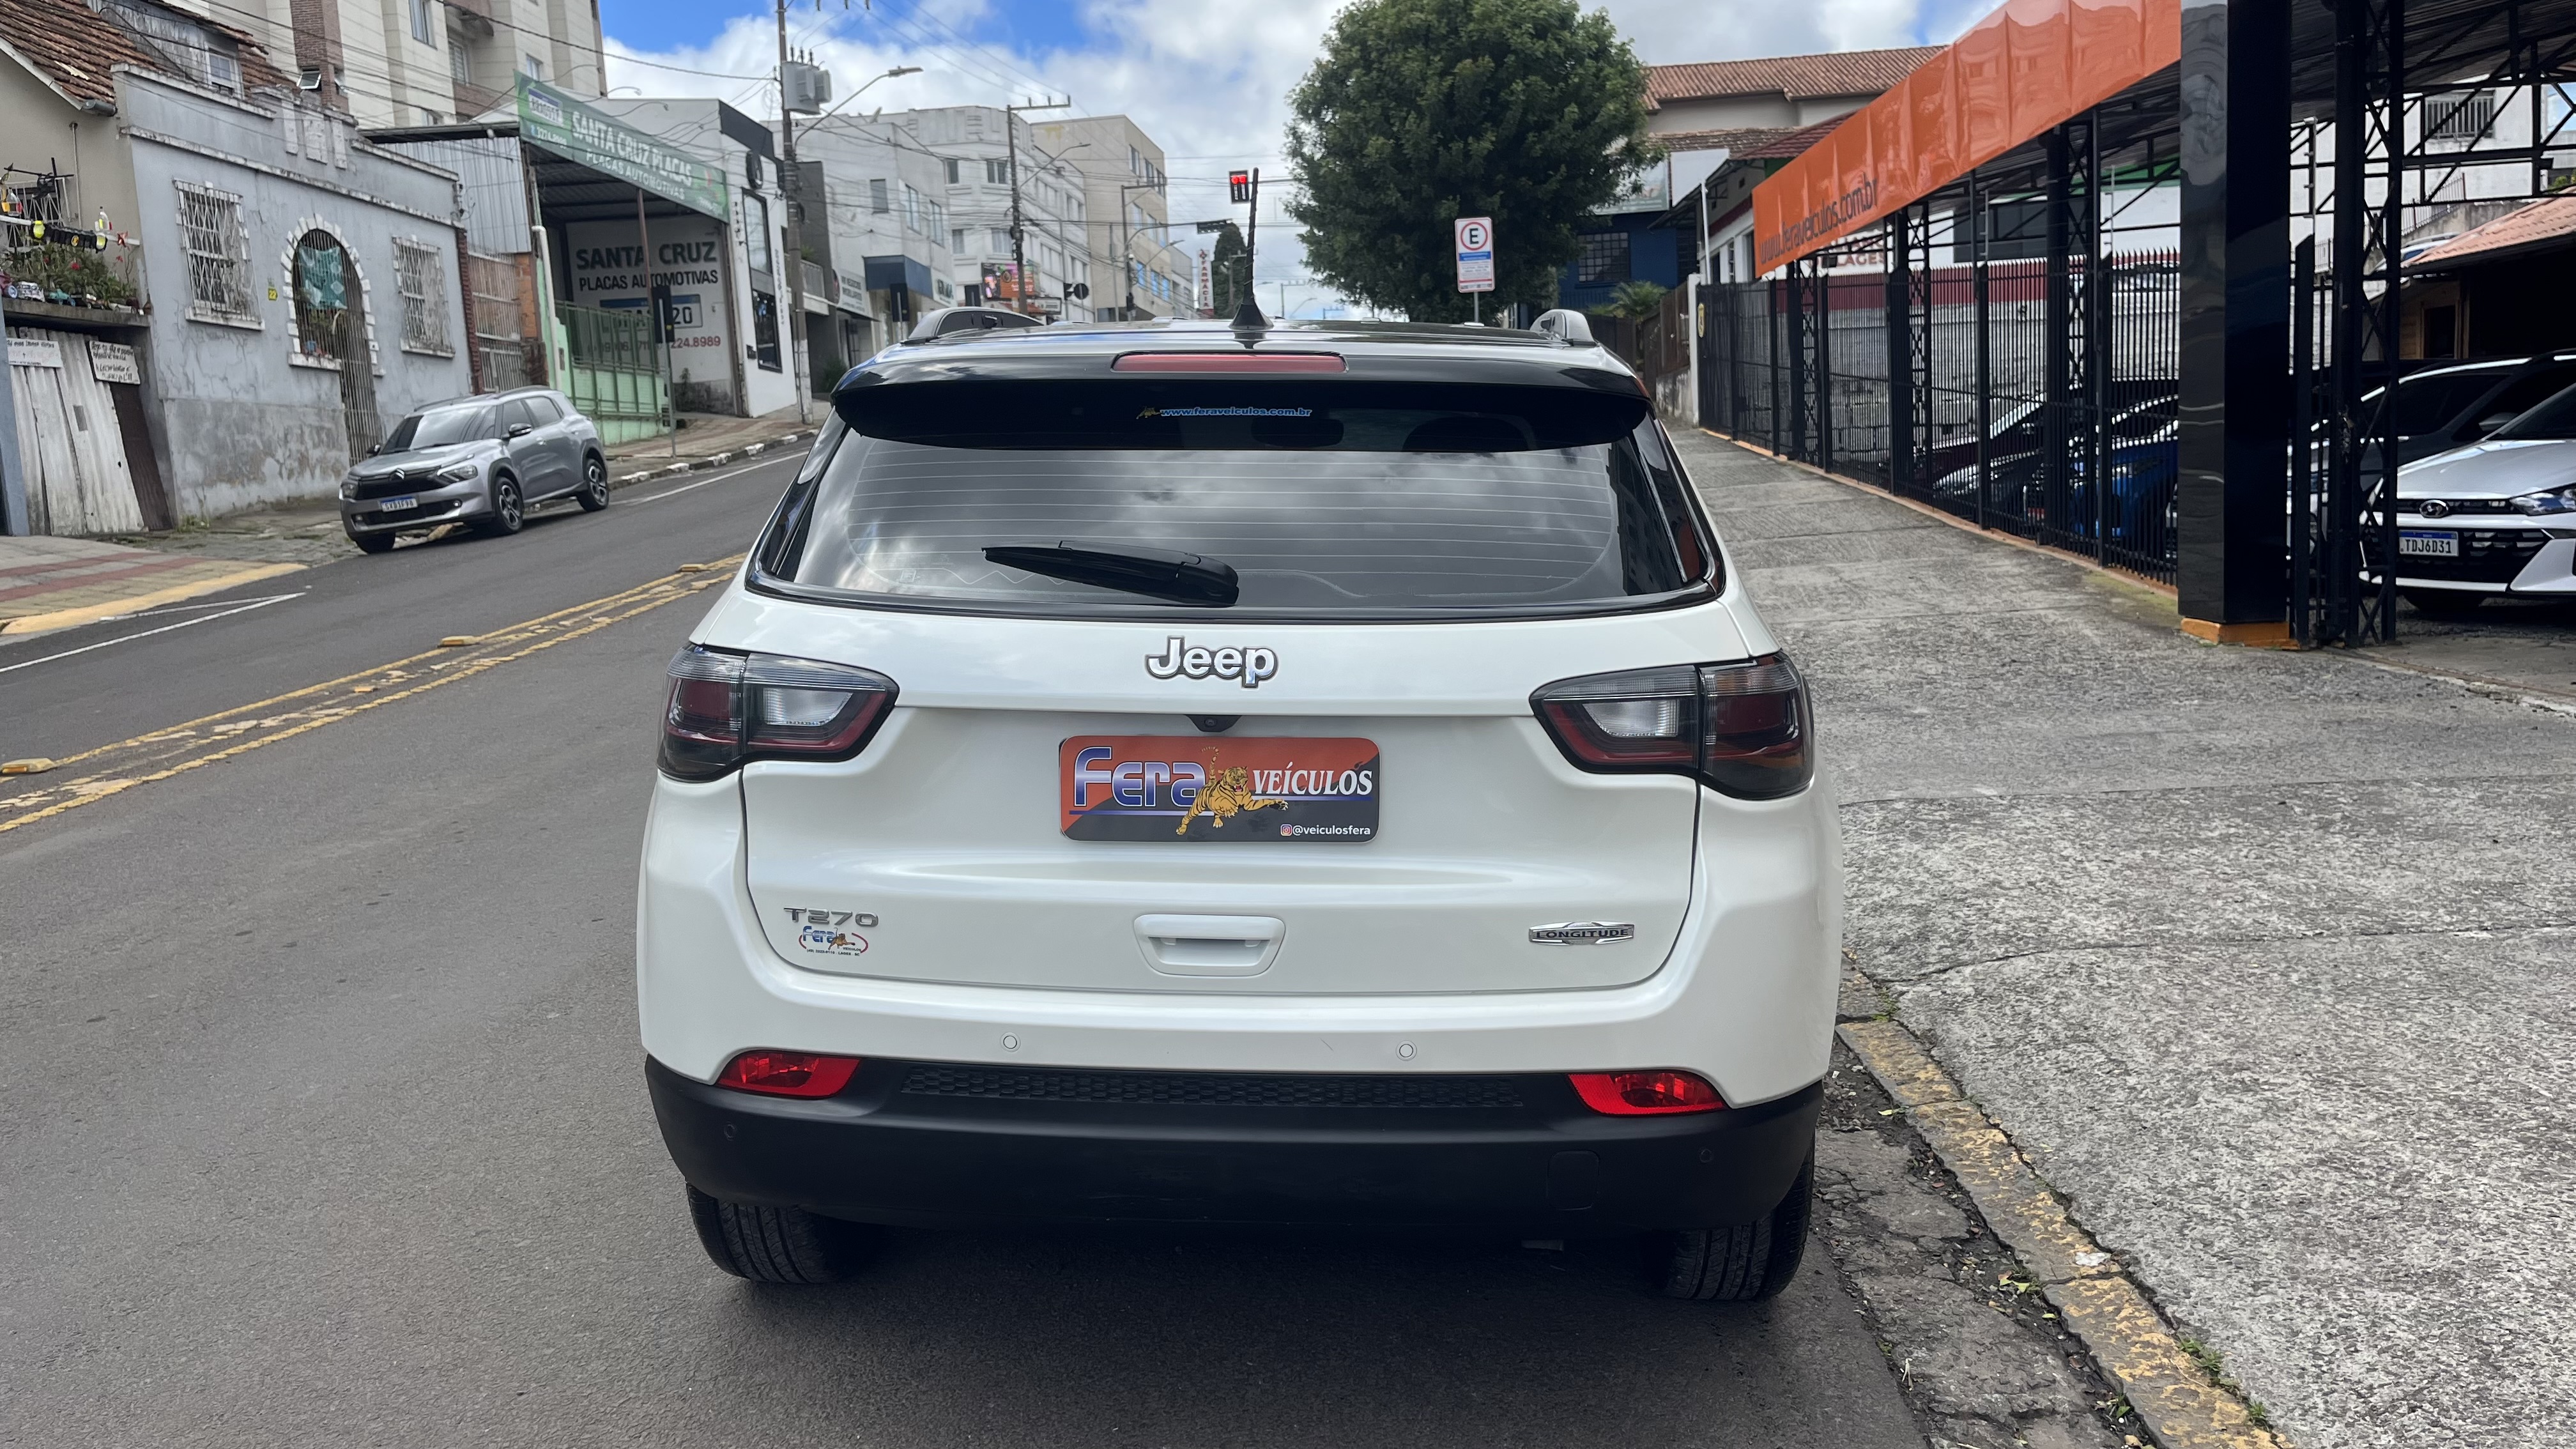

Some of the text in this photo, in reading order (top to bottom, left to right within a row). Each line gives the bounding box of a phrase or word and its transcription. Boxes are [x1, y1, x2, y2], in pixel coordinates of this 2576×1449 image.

[572, 111, 693, 187] SANTA CRUZ PLACAS
[586, 148, 686, 201] PLACAS AUTOMOTIVAS
[1759, 171, 1878, 265] www.feraveiculos.com.br
[1469, 227, 1479, 245] E
[576, 241, 717, 270] SANTA CRUZ
[579, 275, 629, 291] PLACAS
[1160, 407, 1312, 417] www.feraveiculos.com.br
[2405, 539, 2451, 554] TDJ6D31
[1146, 636, 1278, 689] Jeep
[1074, 746, 1373, 807] Fera VEÍCULOS
[1292, 825, 1371, 837] @veiculosfera
[783, 907, 879, 928] T270
[802, 925, 836, 944] Fera
[1536, 928, 1629, 939] LONGITUDE
